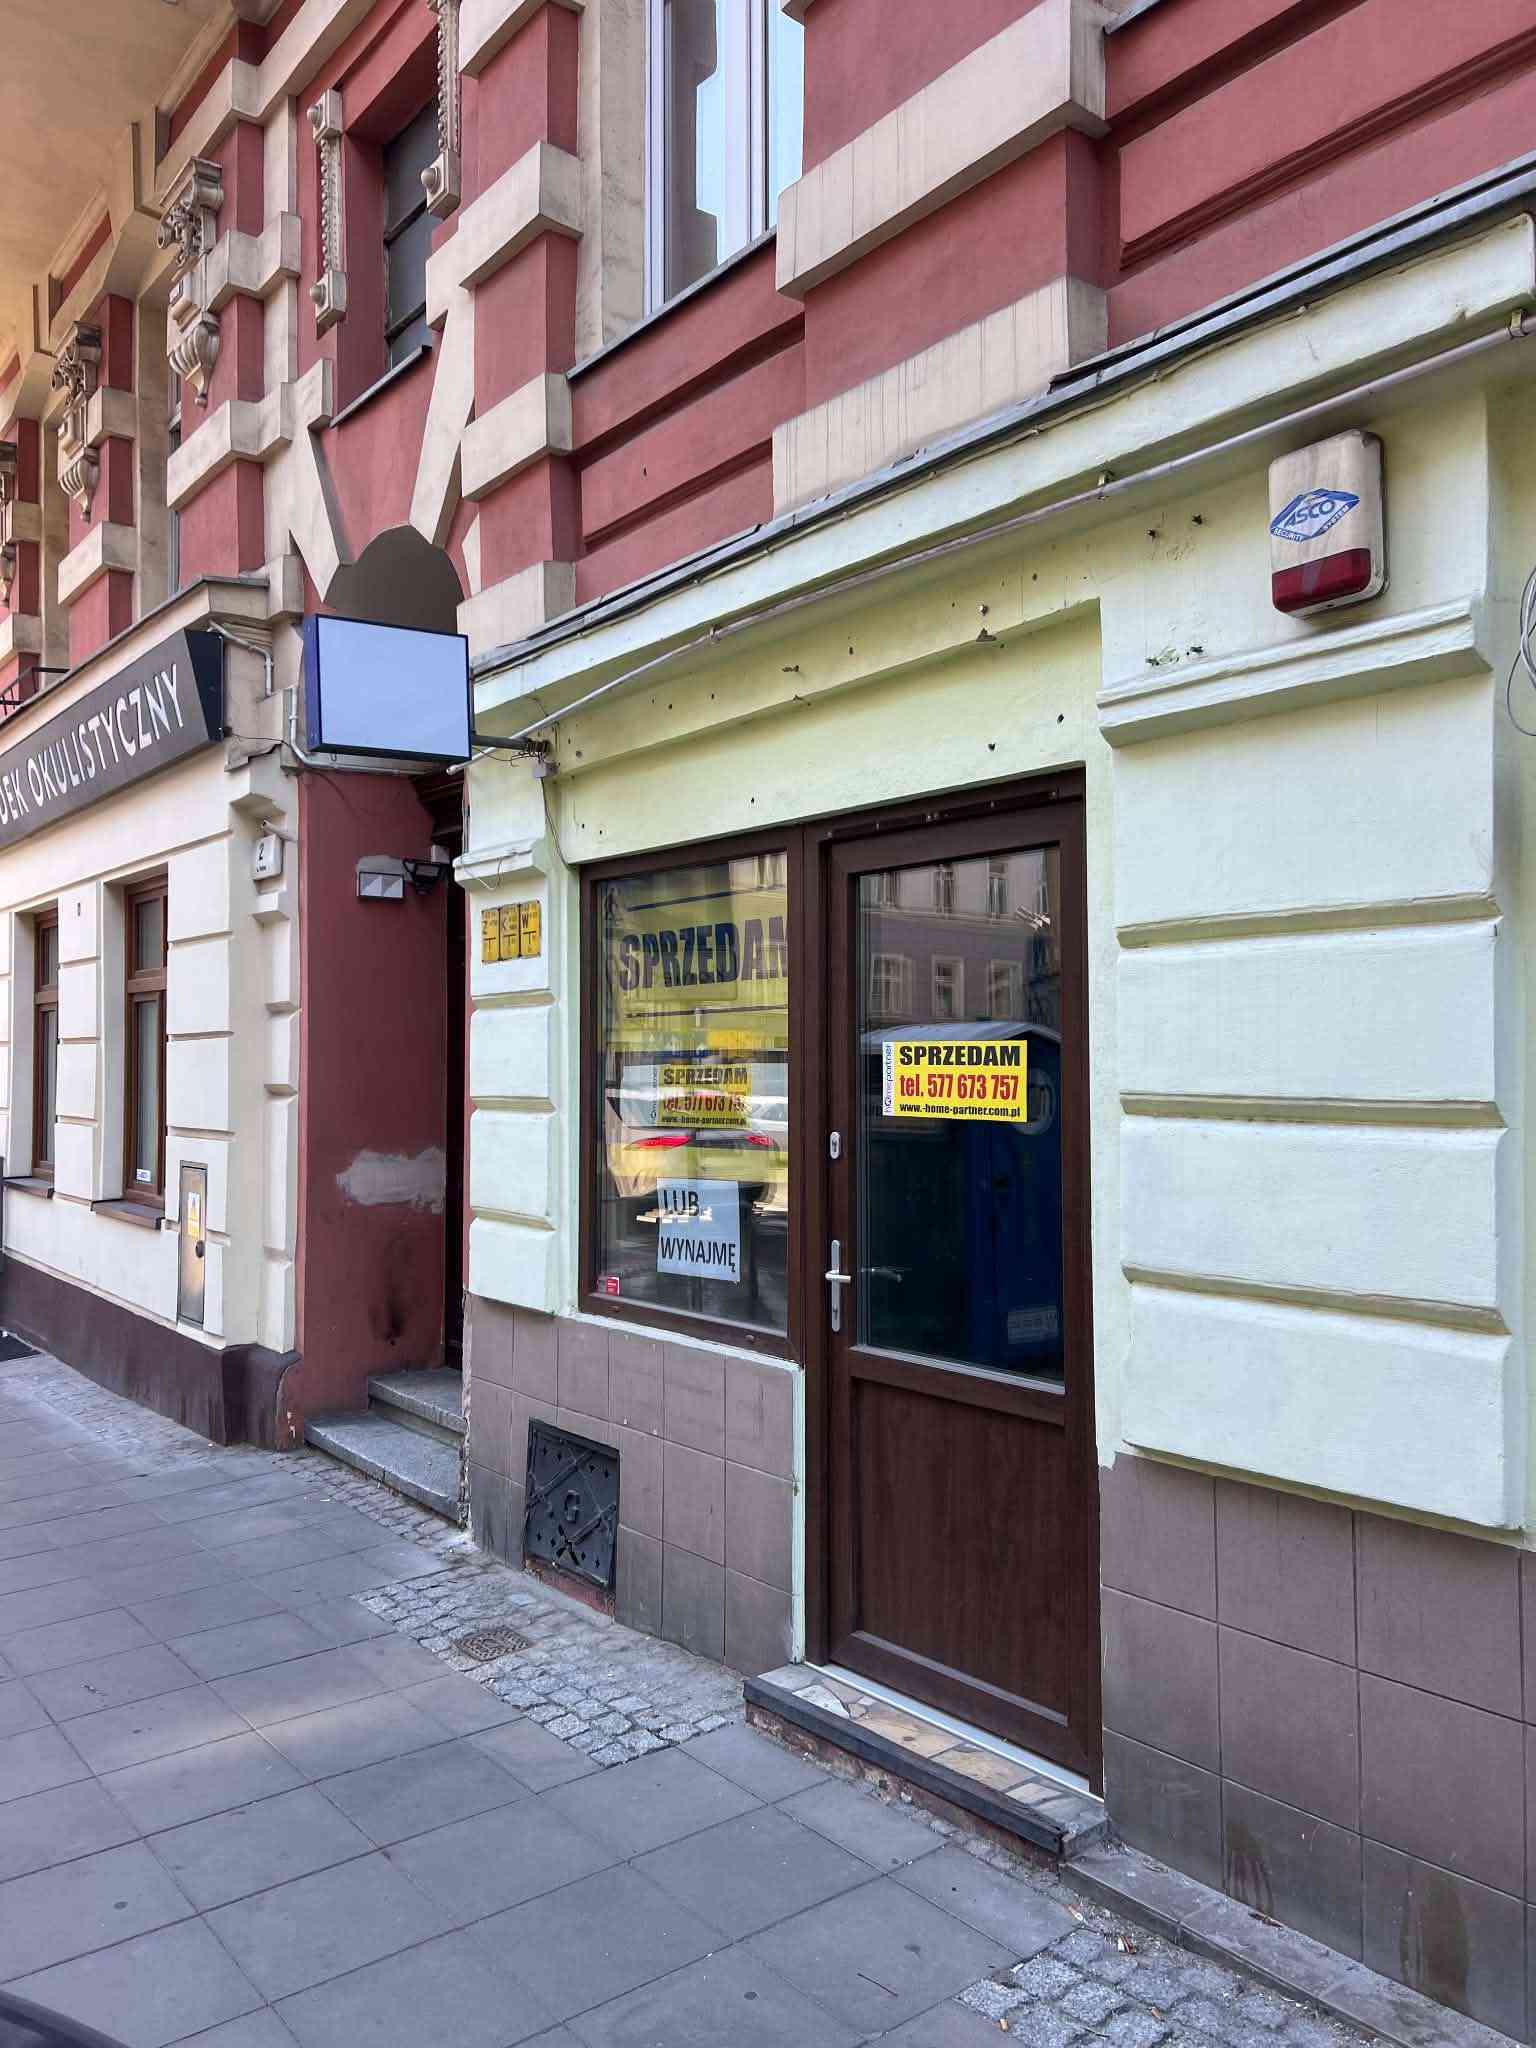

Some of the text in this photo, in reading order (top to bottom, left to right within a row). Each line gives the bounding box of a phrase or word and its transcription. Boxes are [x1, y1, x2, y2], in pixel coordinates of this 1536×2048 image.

[1283, 499, 1336, 528] ASCO
[27, 663, 184, 808] OKULISTYCZNY
[899, 1045, 1021, 1067] SPRZEDAM
[663, 1068, 748, 1085] SPRZEDAM
[900, 1073, 1019, 1100] tel. 577 673 757
[663, 1189, 699, 1216] LUB
[660, 1237, 736, 1273] WYNAJMĘ
